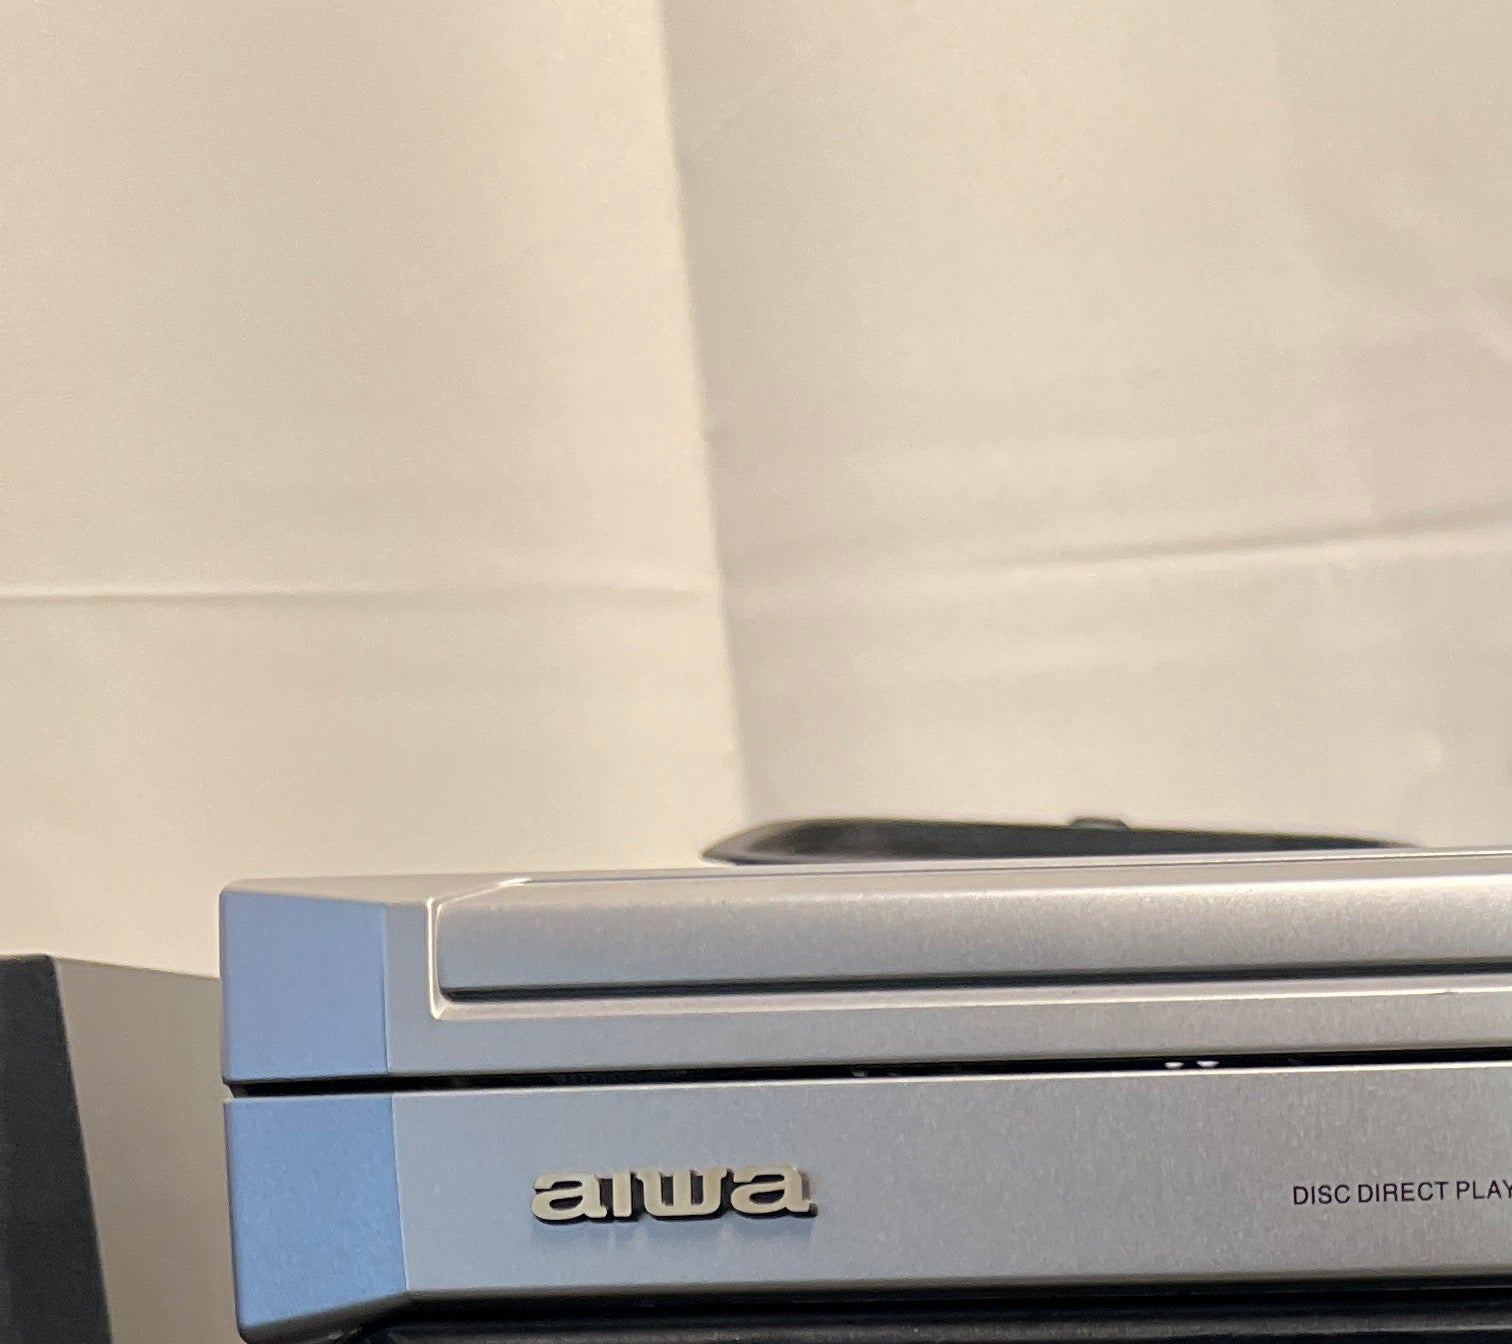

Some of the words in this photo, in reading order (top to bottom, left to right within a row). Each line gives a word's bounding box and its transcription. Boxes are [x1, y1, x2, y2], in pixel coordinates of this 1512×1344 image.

[531, 1163, 817, 1223] aiwa
[1292, 1183, 1351, 1206] DISC
[1357, 1181, 1449, 1203] DIRECT
